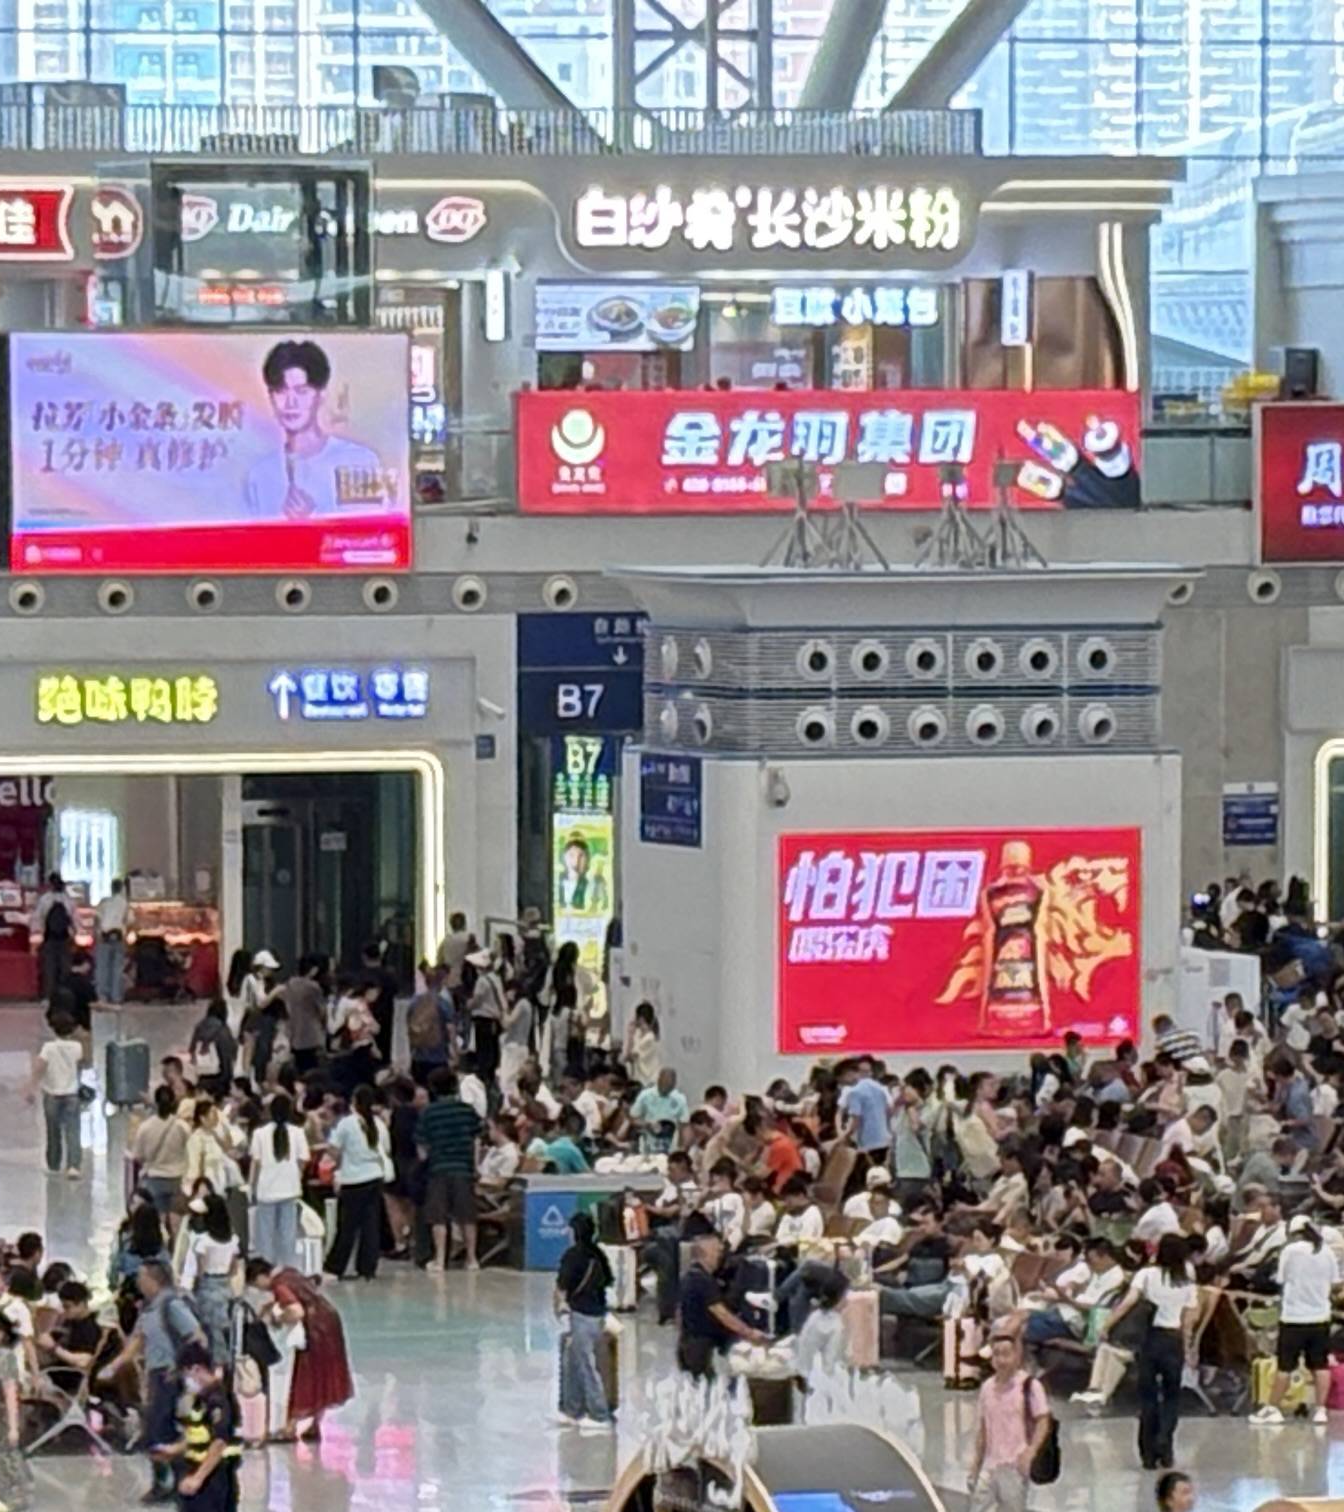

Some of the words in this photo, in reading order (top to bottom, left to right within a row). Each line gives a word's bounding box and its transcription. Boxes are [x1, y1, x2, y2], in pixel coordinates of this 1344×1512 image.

[660, 409, 977, 466] 金龙羽集团
[37, 674, 218, 724] 绝味鸭脖
[557, 683, 605, 718] B7
[566, 743, 602, 774] B7
[783, 850, 987, 921] 怕犯困
